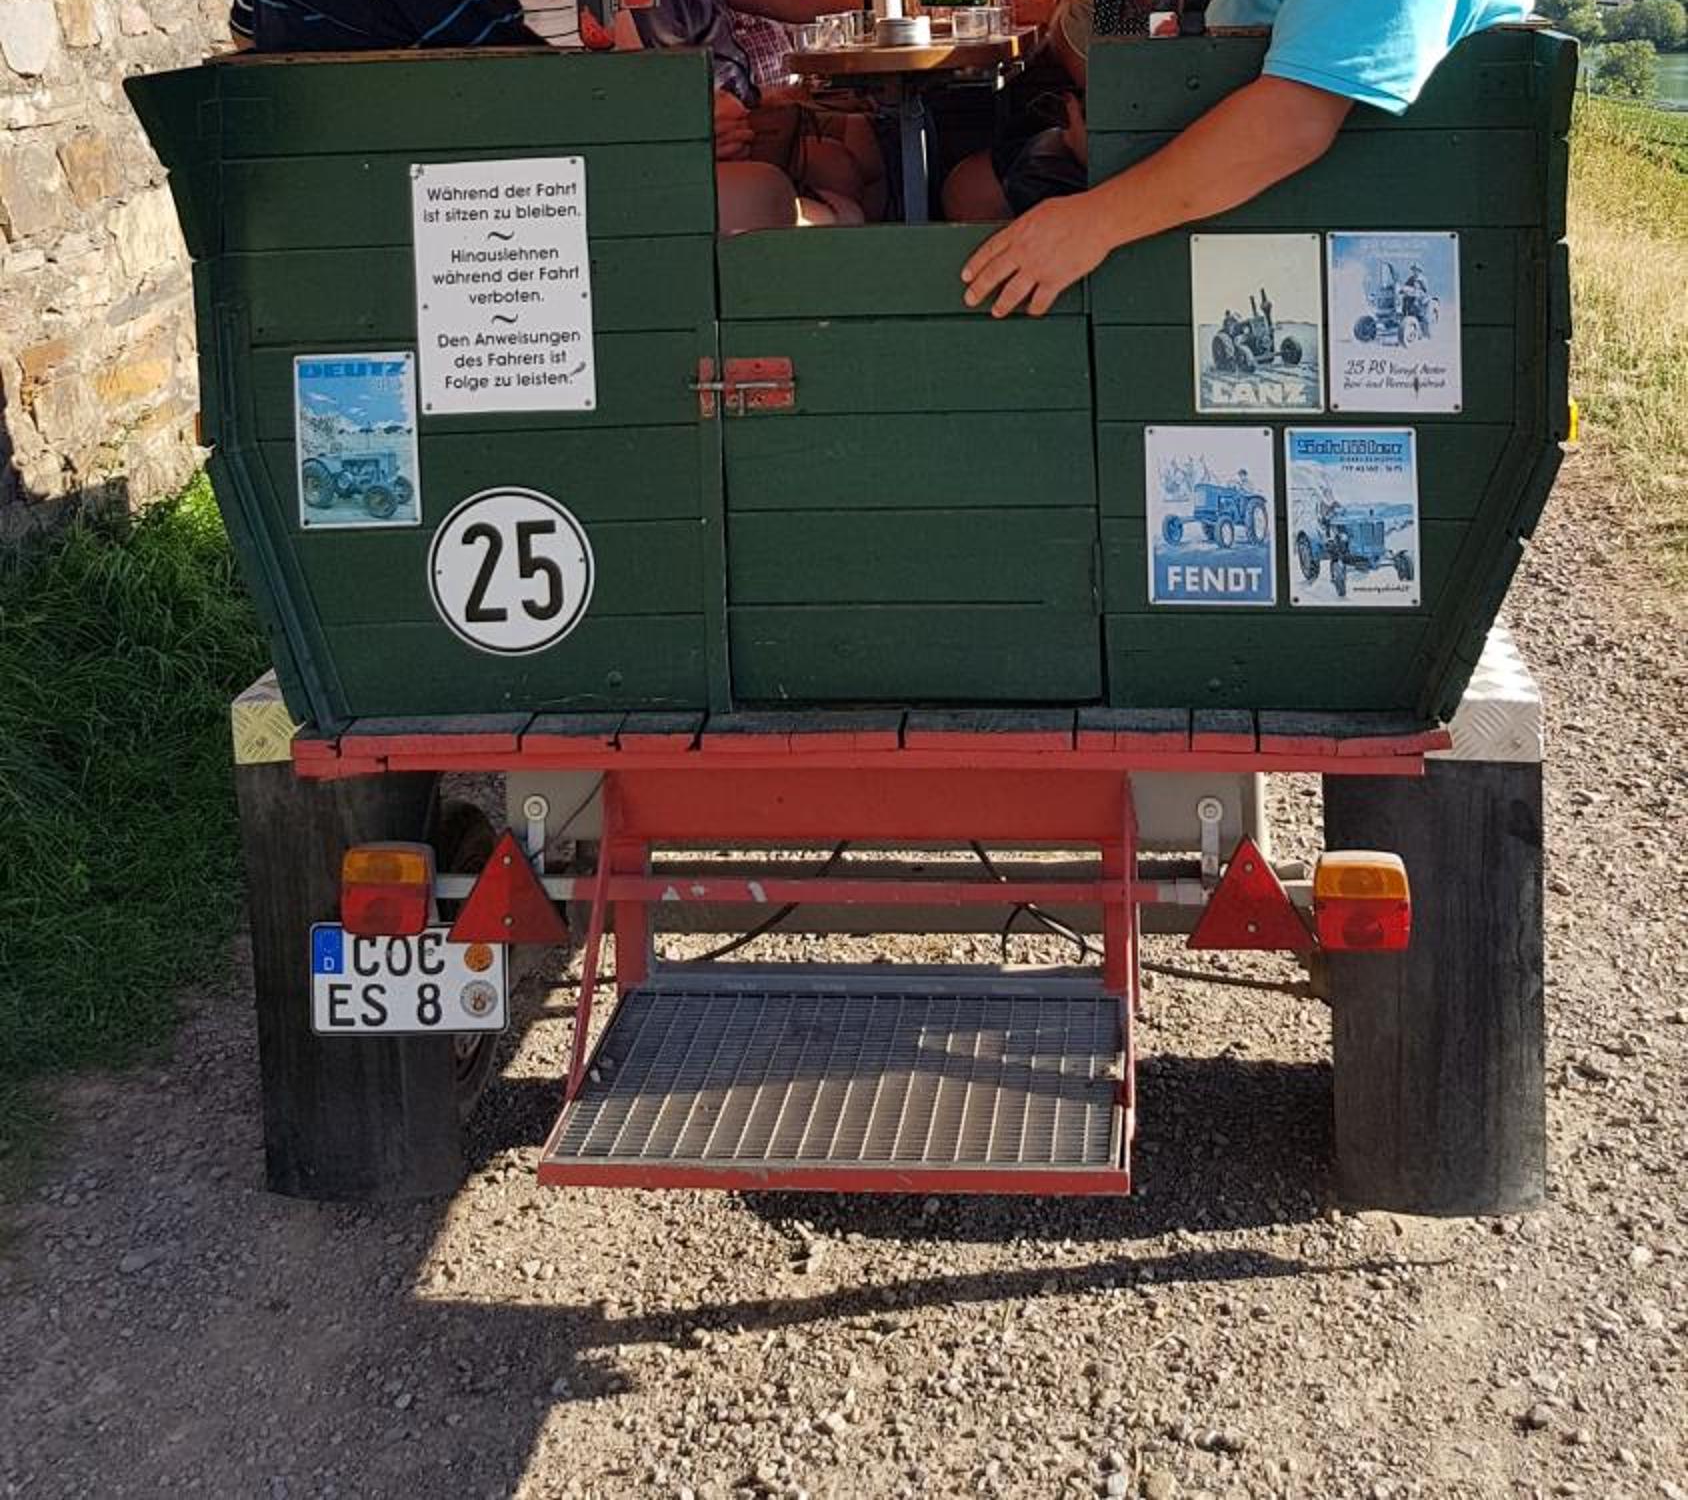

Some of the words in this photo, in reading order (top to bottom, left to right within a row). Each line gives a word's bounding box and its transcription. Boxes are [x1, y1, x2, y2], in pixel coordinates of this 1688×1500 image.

[427, 186, 499, 201] Während
[505, 184, 531, 198] der
[536, 182, 577, 197] Fahrt
[423, 208, 439, 222] ist
[445, 208, 489, 222] sitzen
[493, 209, 511, 220] zu
[516, 204, 582, 219] bleiben.
[451, 248, 559, 263] Hinauslehnen
[432, 269, 502, 285] während
[507, 268, 534, 283] der
[539, 266, 579, 280] Fahrt
[468, 290, 544, 304] verboten.
[438, 333, 470, 348] Den
[475, 331, 581, 347] Anweisungen
[454, 354, 483, 368] des
[487, 352, 545, 367] Fahrers
[550, 350, 567, 363] ist
[299, 362, 406, 379] DEUTZ
[445, 375, 489, 392] Folge
[494, 377, 511, 387] zu
[516, 372, 573, 386] leisten.
[461, 519, 565, 623] 25
[1167, 564, 1263, 592] FENDT
[323, 956, 335, 971] D
[328, 983, 388, 1026] ES
[416, 982, 443, 1026] 8
